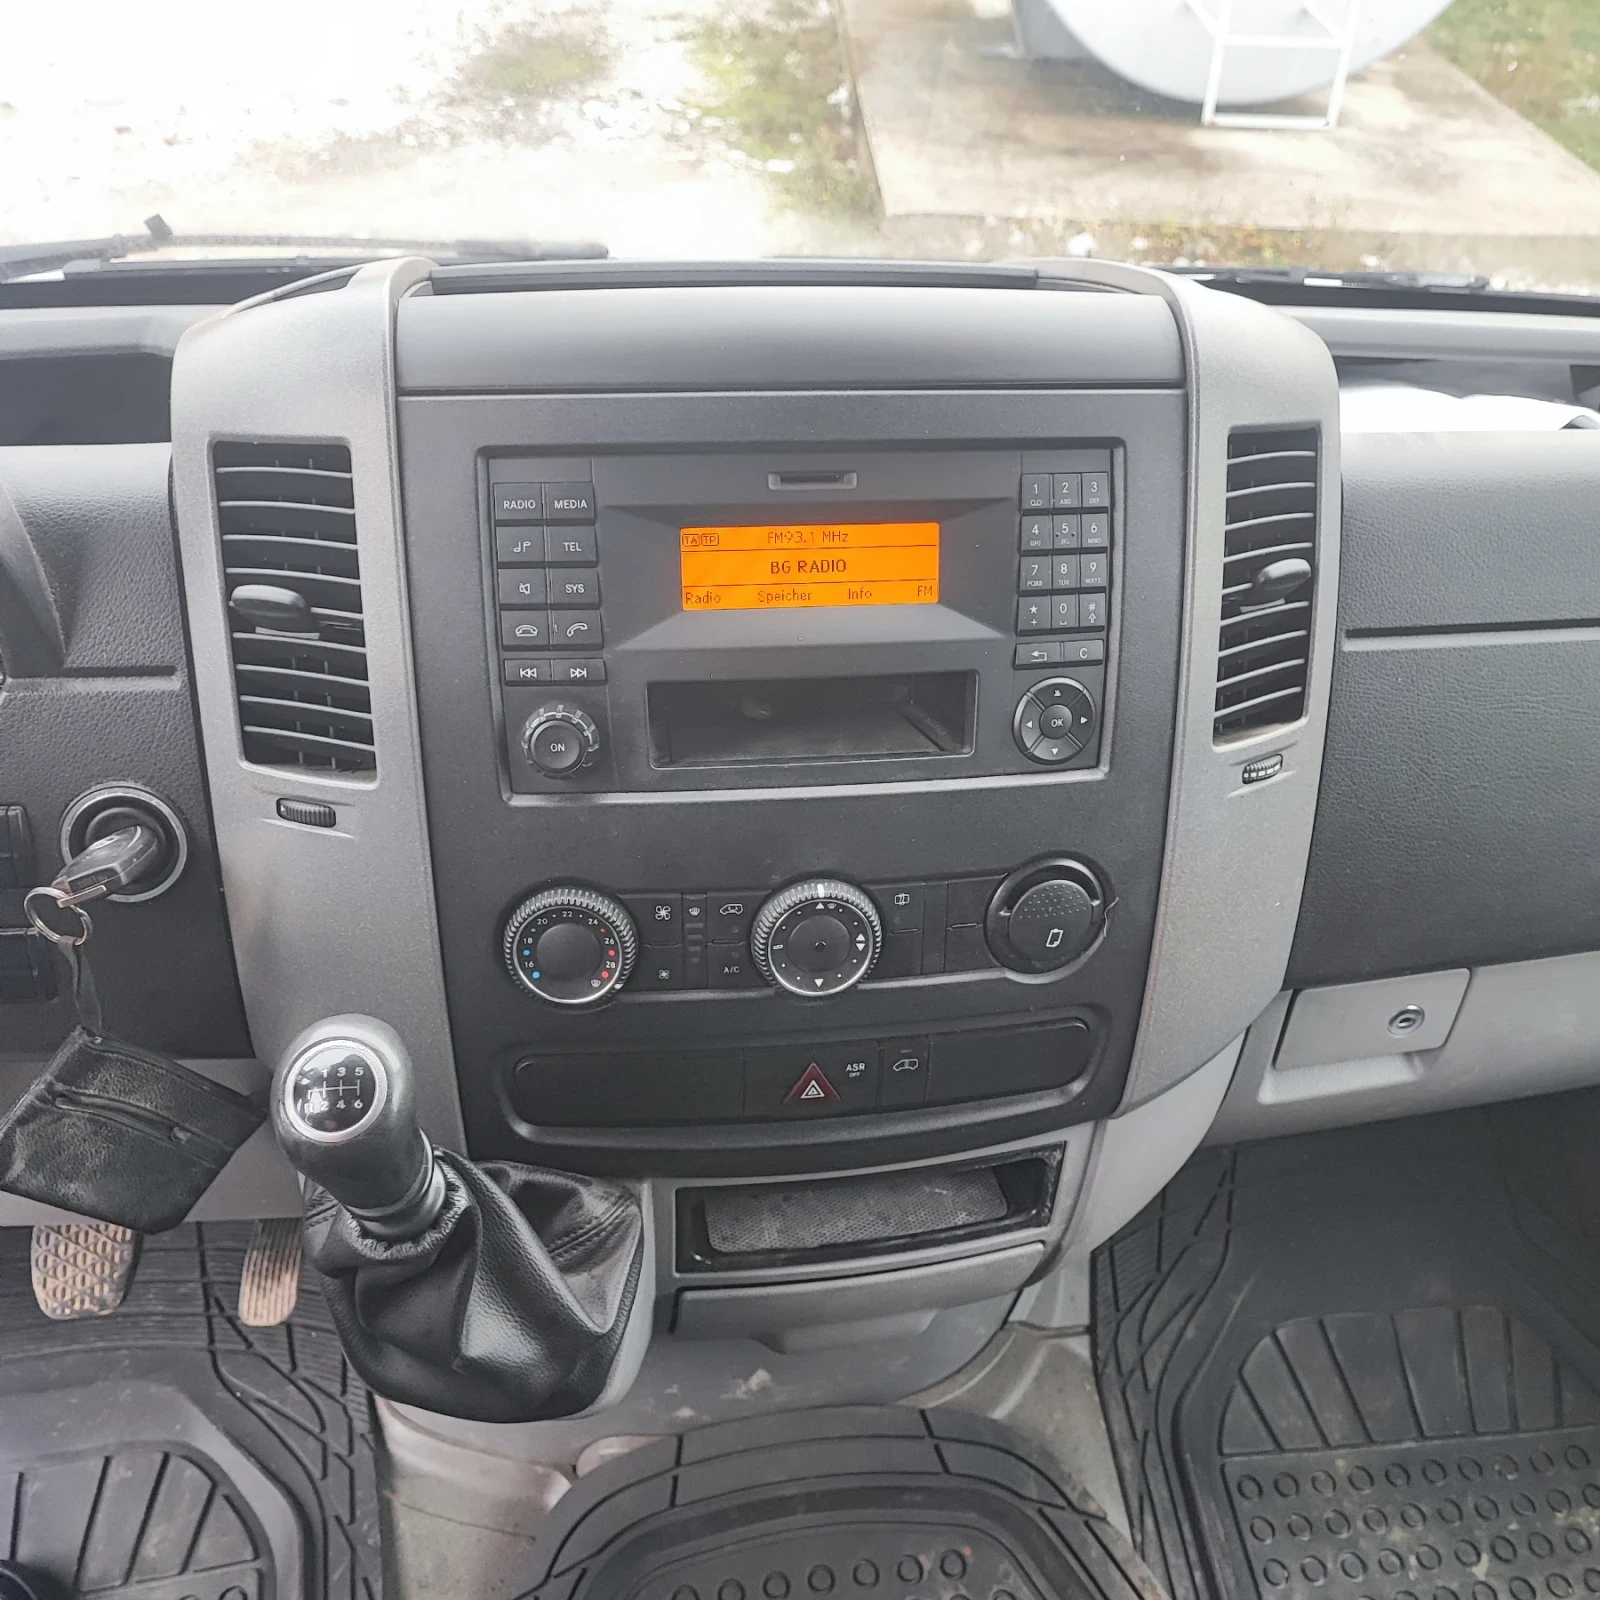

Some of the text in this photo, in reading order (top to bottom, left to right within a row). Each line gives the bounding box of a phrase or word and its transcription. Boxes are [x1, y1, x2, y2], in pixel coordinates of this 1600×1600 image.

[1033, 483, 1038, 495] 1
[1061, 482, 1069, 493] 2
[1090, 481, 1098, 493] 3
[503, 500, 536, 509] RADIO
[554, 499, 588, 509] MEDIA
[1031, 523, 1039, 535] 4
[1061, 523, 1069, 534] 5
[1090, 522, 1098, 534] 6
[767, 531, 849, 544] FM93.1 MHz
[563, 542, 582, 552] TEL
[770, 559, 847, 574] BG RADIO
[1031, 564, 1039, 576] 7
[1060, 563, 1068, 574] 8
[1089, 562, 1097, 573] 9
[565, 583, 585, 594] SYS
[685, 585, 932, 605] Radio Speicher Info FM
[1059, 603, 1067, 614] 0
[1079, 647, 1088, 659] C
[1051, 718, 1064, 728] OK
[550, 743, 565, 752] ON
[604, 937, 615, 945] 26
[605, 961, 616, 969] 28
[723, 965, 740, 974] A/C
[336, 1067, 346, 1077] 3
[354, 1066, 364, 1076] 5
[845, 1062, 865, 1072] ASR
[321, 1068, 328, 1078] 1
[320, 1101, 329, 1111] 2
[336, 1099, 346, 1109] 4
[354, 1098, 364, 1109] 6
